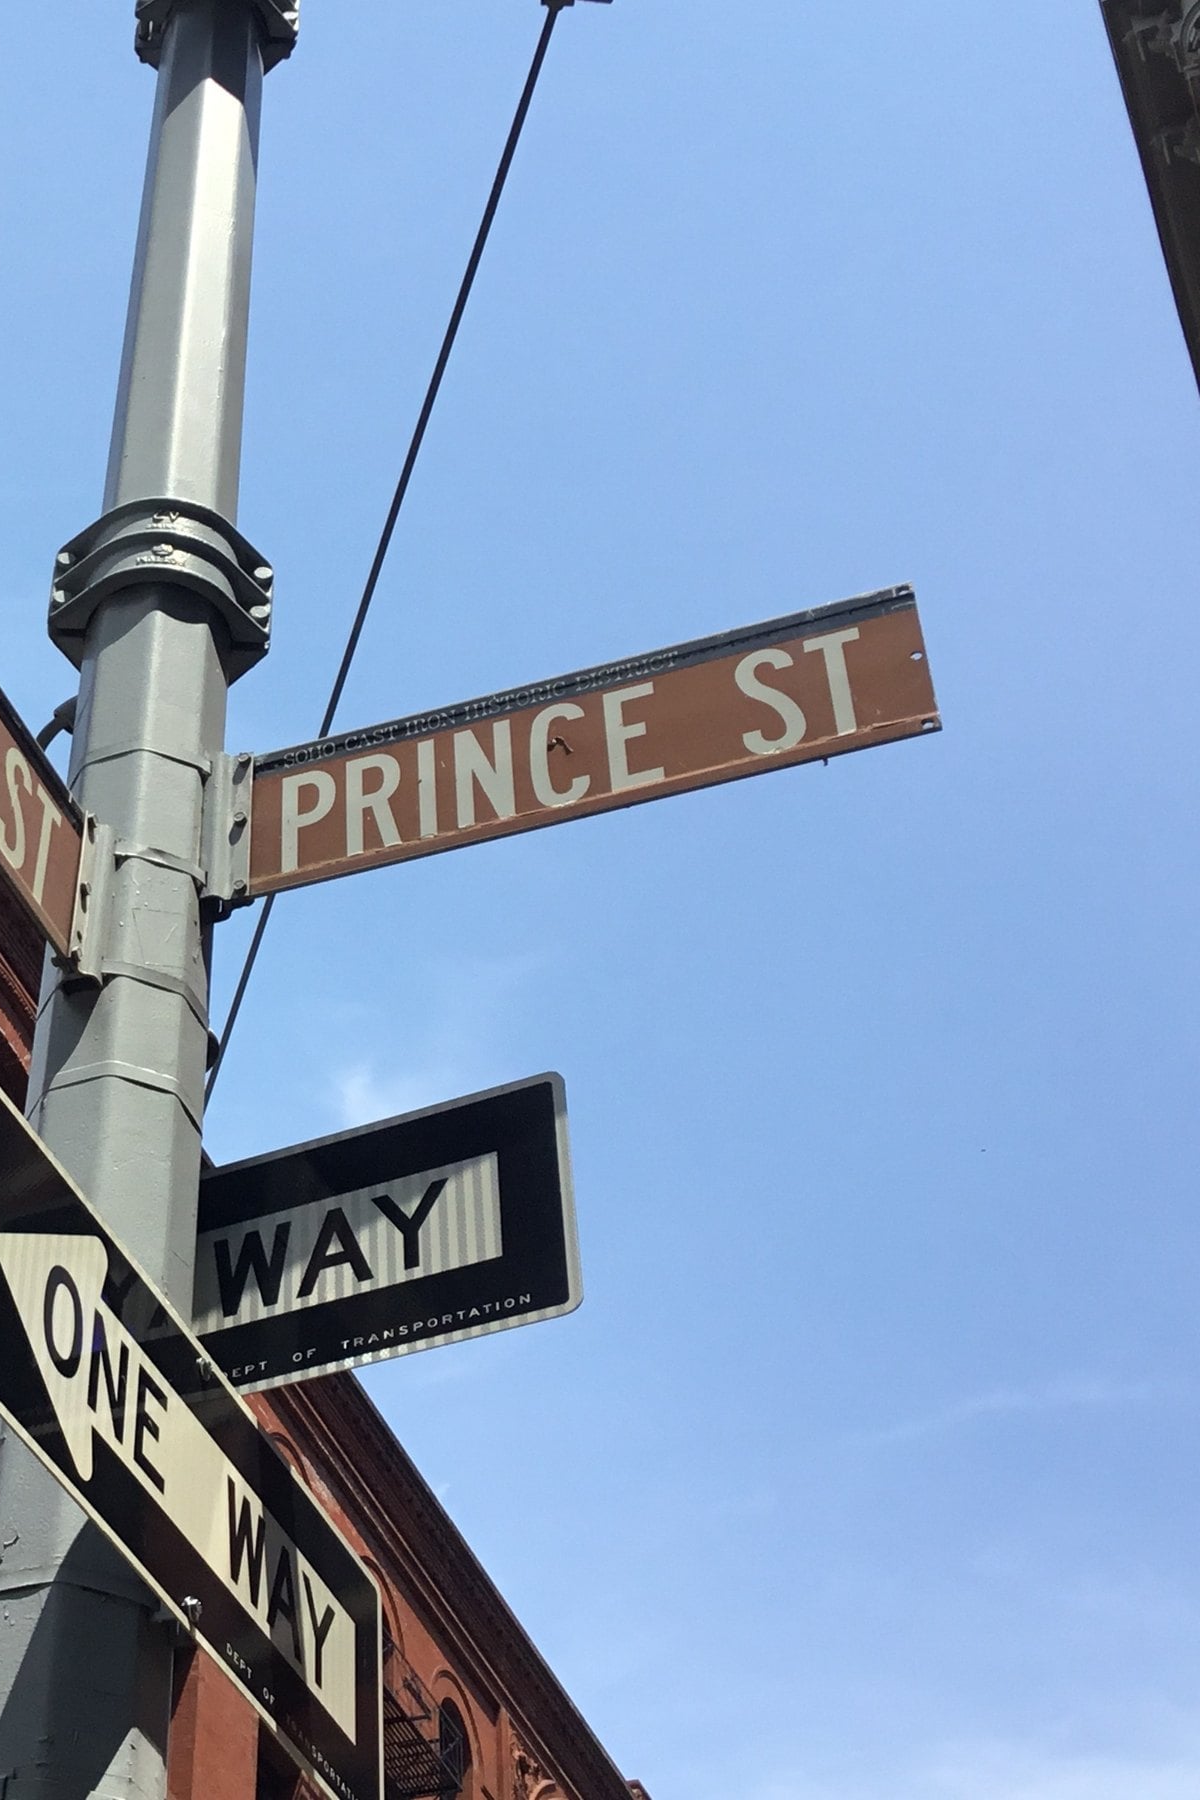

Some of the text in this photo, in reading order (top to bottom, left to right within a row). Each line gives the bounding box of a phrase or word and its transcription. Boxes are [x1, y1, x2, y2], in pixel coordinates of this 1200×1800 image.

[404, 709, 456, 736] IRON
[464, 680, 568, 721] HISTORIC
[575, 651, 679, 692] DISTRICT
[281, 628, 860, 874] PRINCE ST
[213, 1178, 449, 1318] WAY
[292, 1348, 316, 1361] OF
[341, 1293, 531, 1350] TRANSPORTATION
[43, 1265, 168, 1495] ONE
[227, 1473, 336, 1690] WAY
[226, 1642, 253, 1679] DEPT
[262, 1687, 275, 1705] OF
